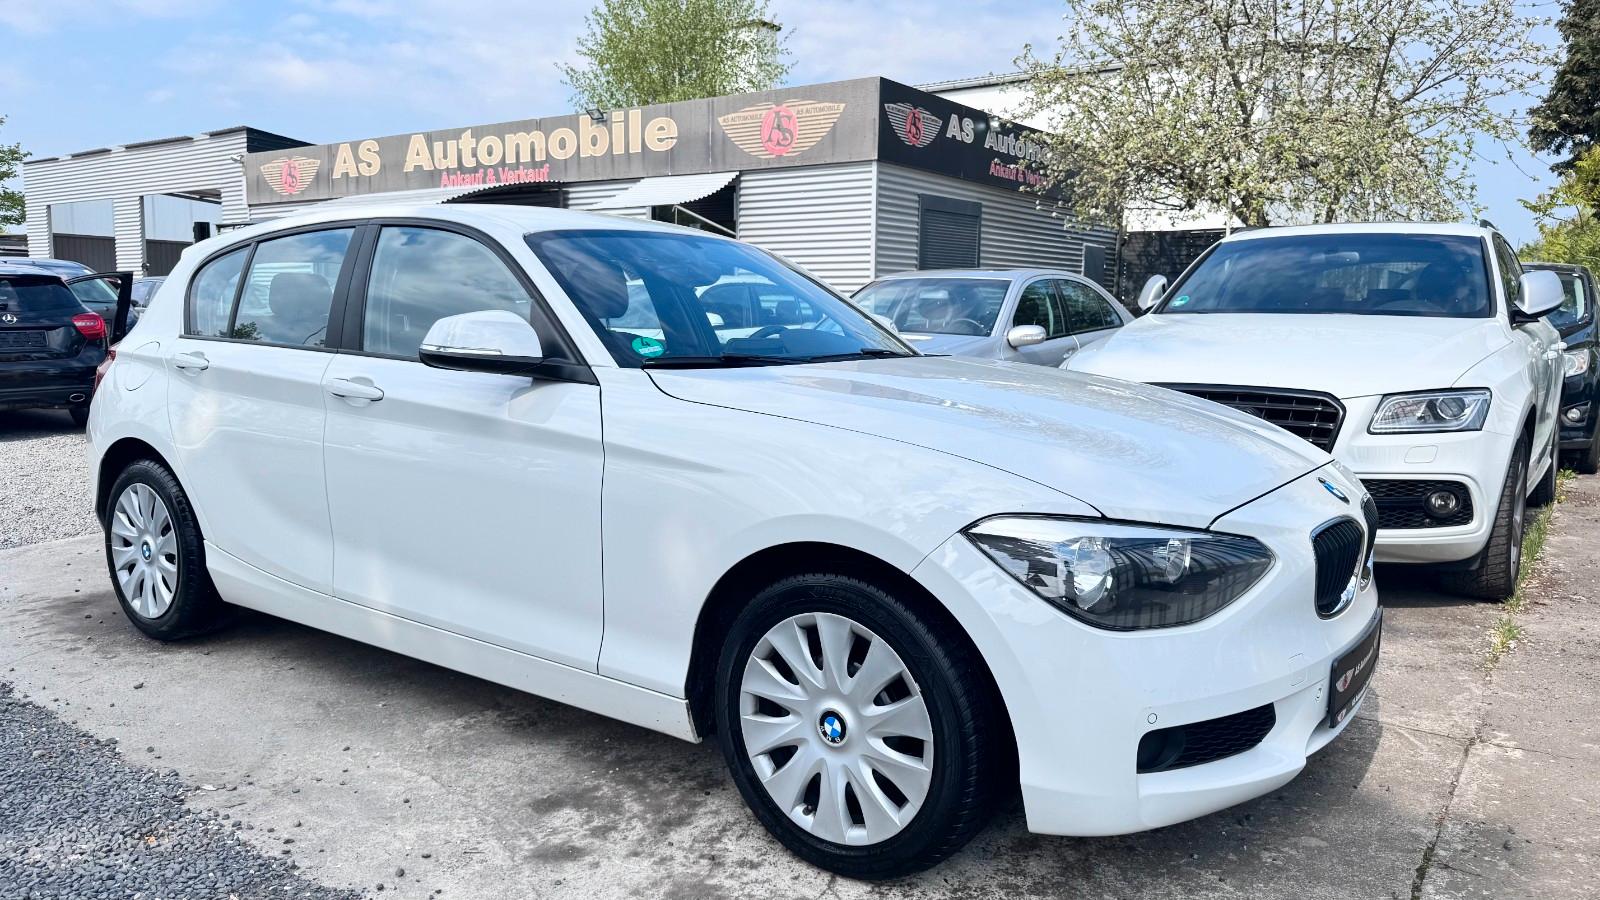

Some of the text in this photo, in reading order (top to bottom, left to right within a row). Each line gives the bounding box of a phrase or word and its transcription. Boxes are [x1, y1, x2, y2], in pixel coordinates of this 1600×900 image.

[946, 114, 975, 144] AS
[332, 109, 678, 179] AS Automobile
[440, 163, 550, 189] Ankauf & Verkauf
[989, 160, 1016, 181] Ankauf
